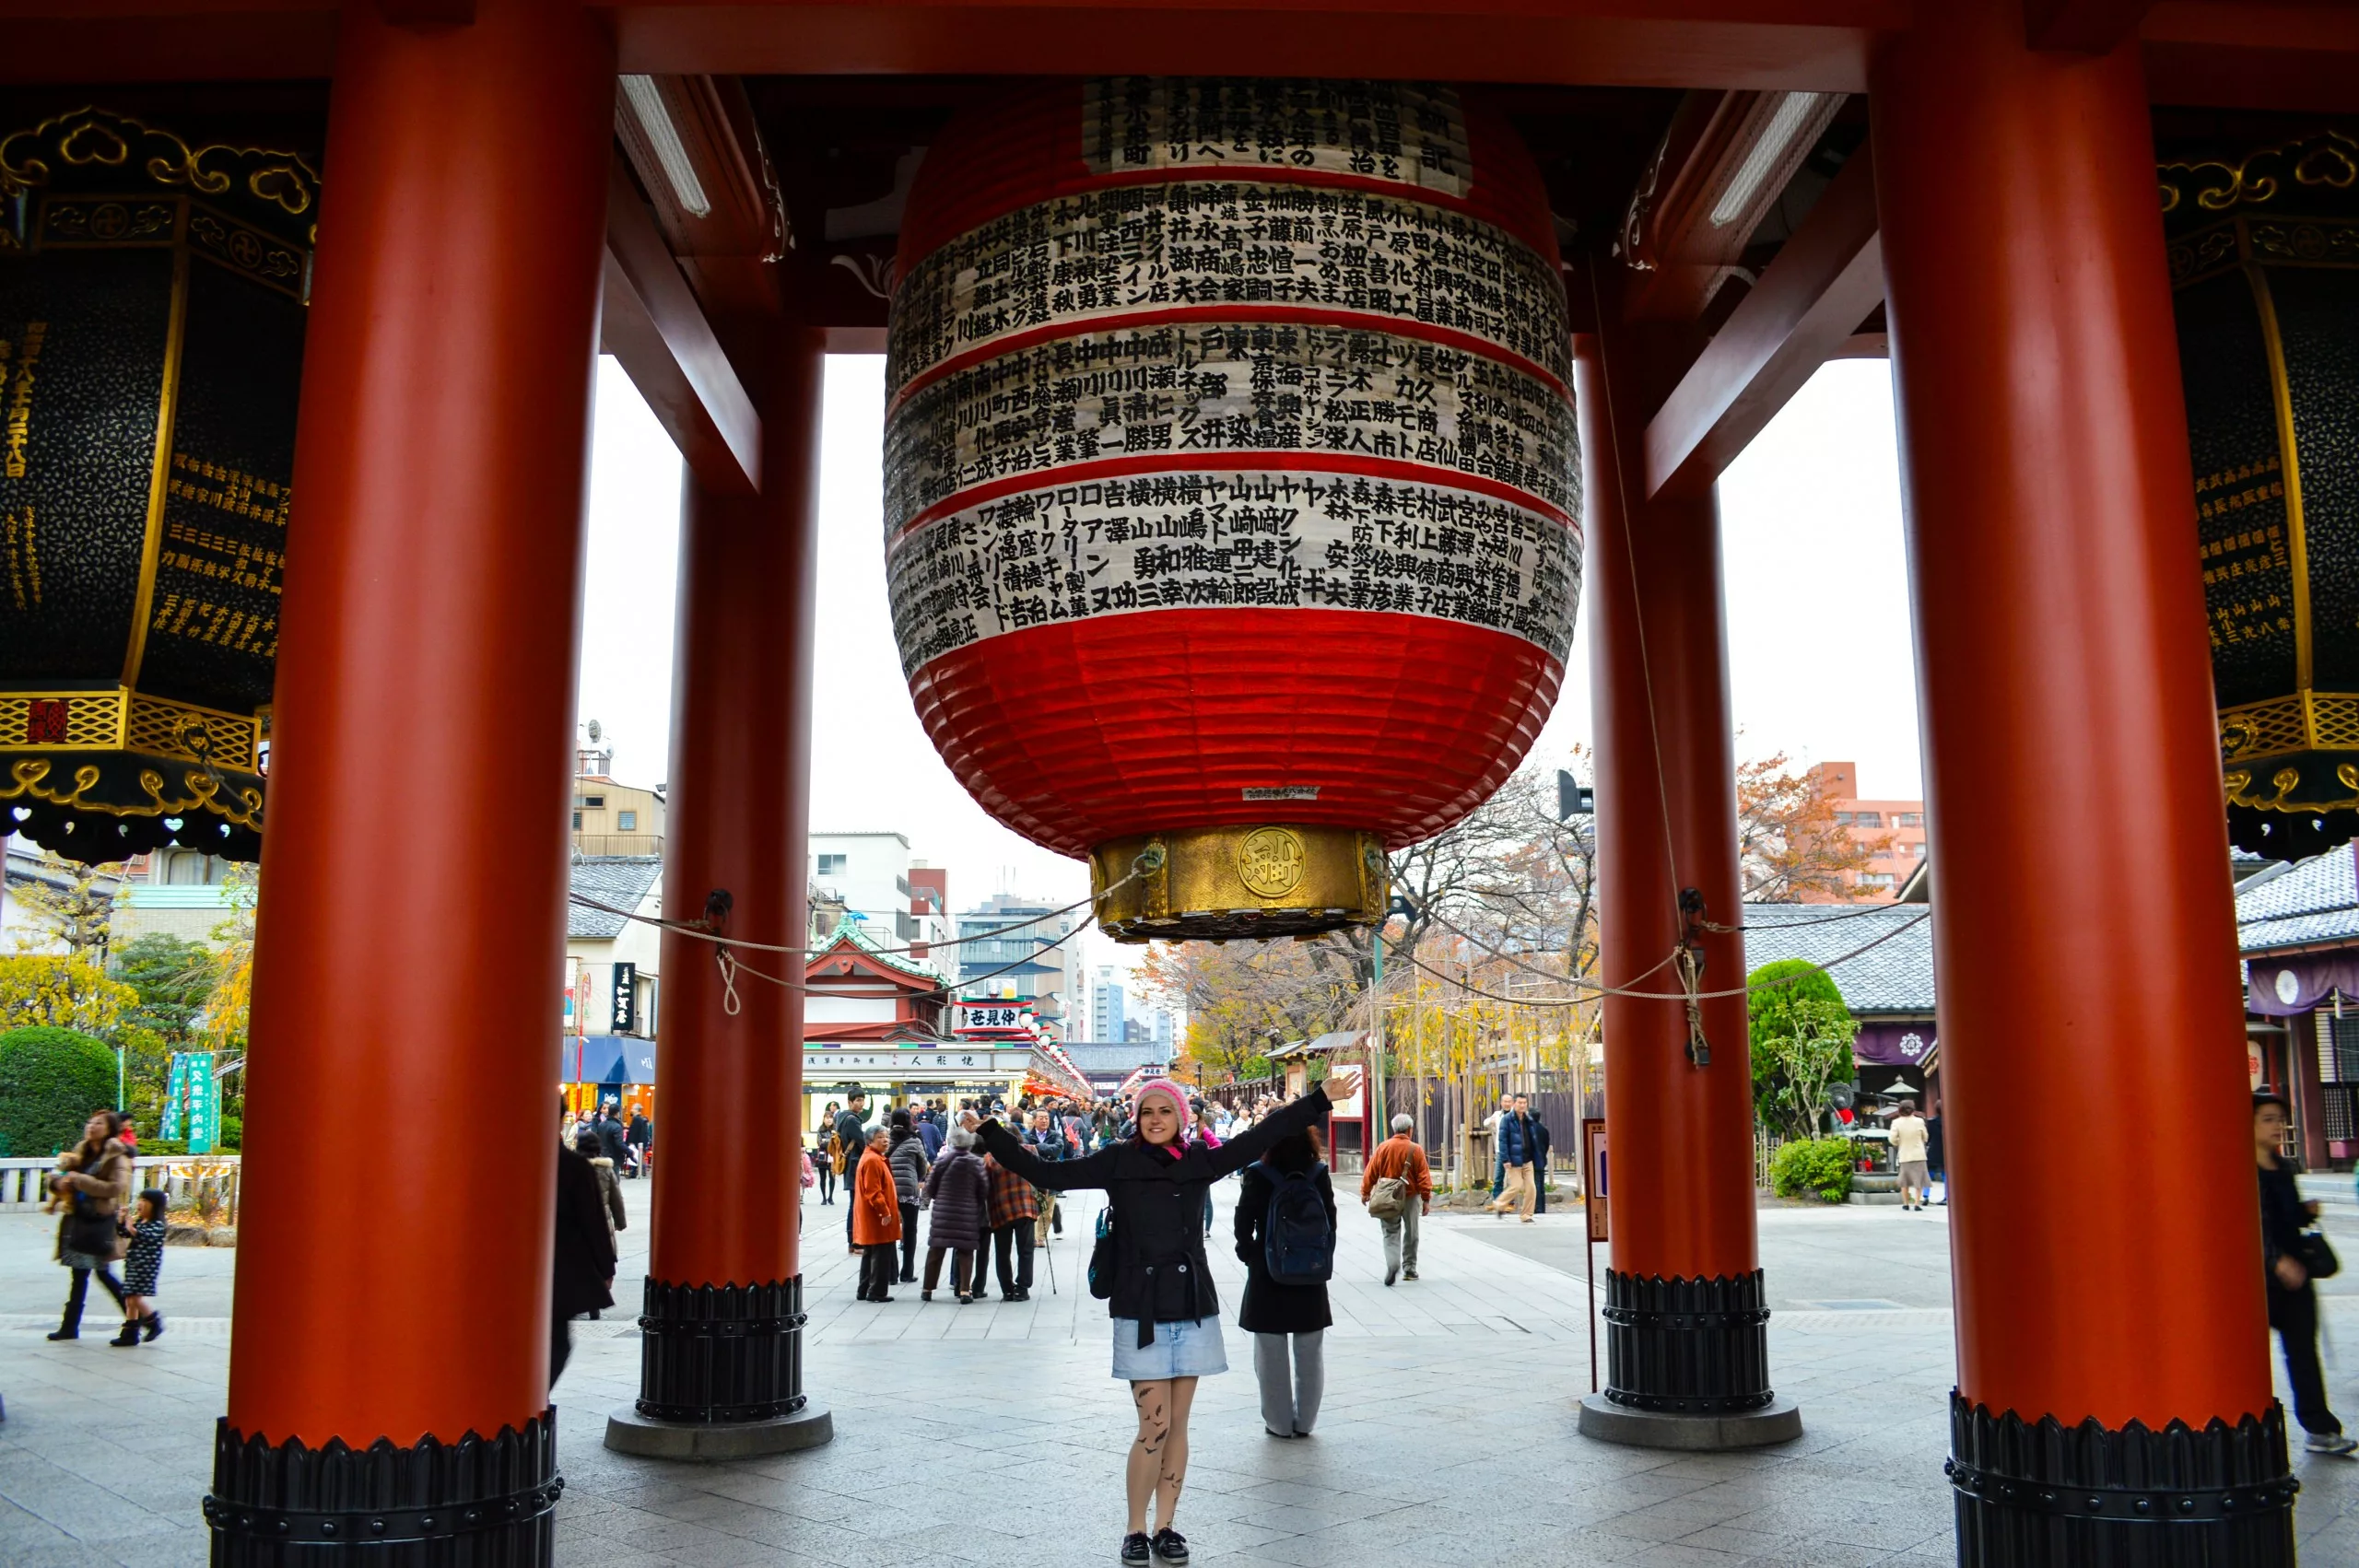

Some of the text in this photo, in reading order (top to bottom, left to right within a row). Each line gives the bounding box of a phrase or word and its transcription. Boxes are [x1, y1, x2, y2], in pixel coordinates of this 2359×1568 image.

[1388, 204, 1414, 316] 小原化工
[1147, 327, 1176, 449] 成瀬仁男
[1178, 328, 1202, 449] トルネックス
[1393, 345, 1416, 459] ツカモト
[1414, 345, 1438, 462] 長久商店
[978, 505, 1010, 633] ワンリード
[1057, 486, 1090, 617] ロータリー製菓
[1080, 484, 1112, 614] ロアンヌ
[1104, 480, 1137, 609] 吉澤功
[1126, 477, 1163, 608] 横山勇三
[1152, 475, 1185, 606] 横山和幸
[1203, 475, 1234, 605] ヤマト運輸
[1278, 474, 1302, 607] ヤクシン化成
[1301, 476, 1327, 602] ヤギ
[1323, 477, 1354, 607] 森安夫
[1349, 476, 1375, 610] 森下防災工業
[1370, 482, 1399, 611] 森下俊彦
